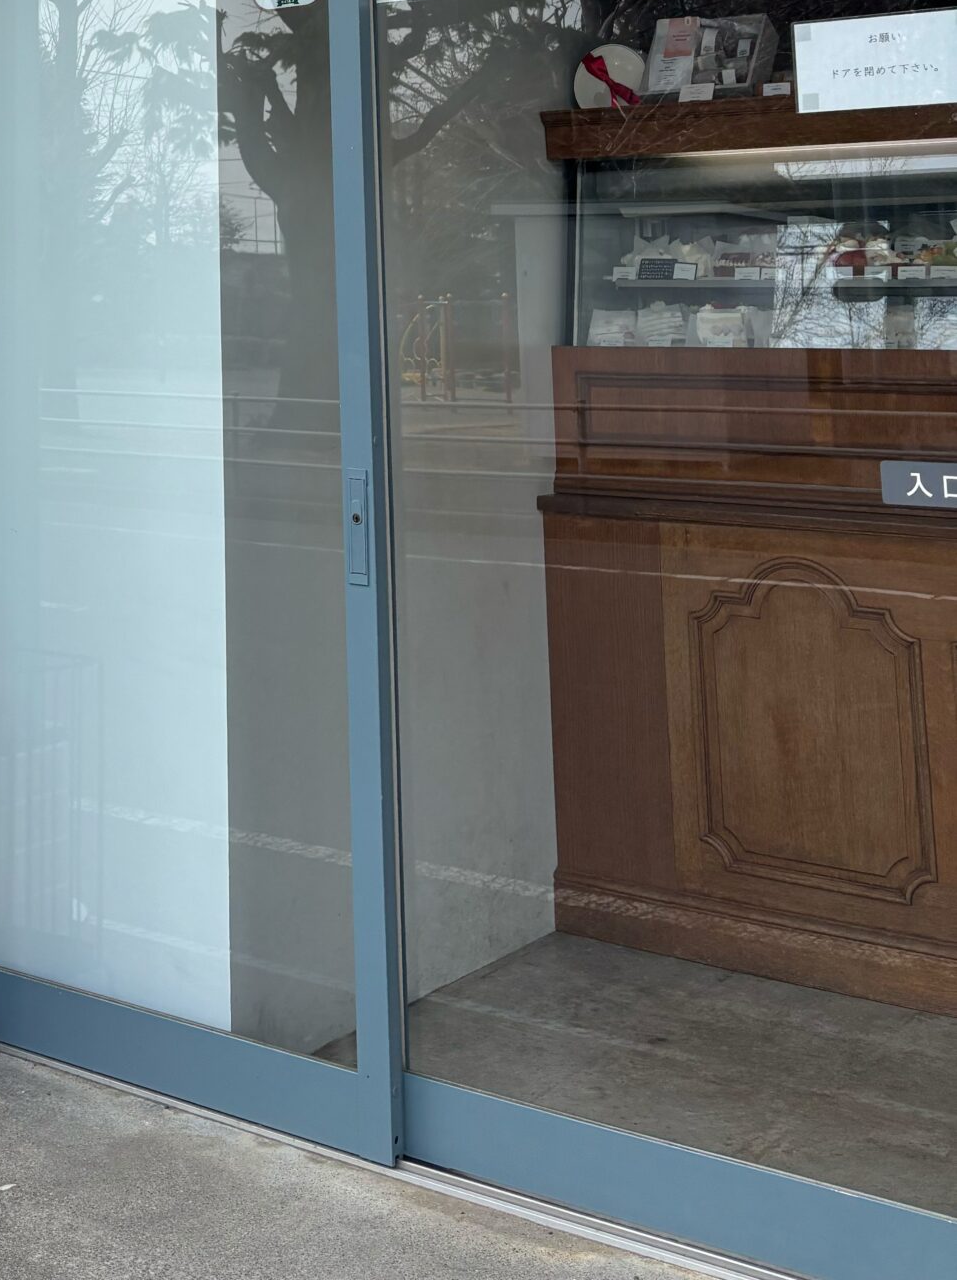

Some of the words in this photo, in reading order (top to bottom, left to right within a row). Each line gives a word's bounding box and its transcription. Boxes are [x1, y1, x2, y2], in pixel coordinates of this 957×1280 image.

[868, 32, 901, 44] お願い
[832, 63, 939, 79] ドアを閉めて下さい。
